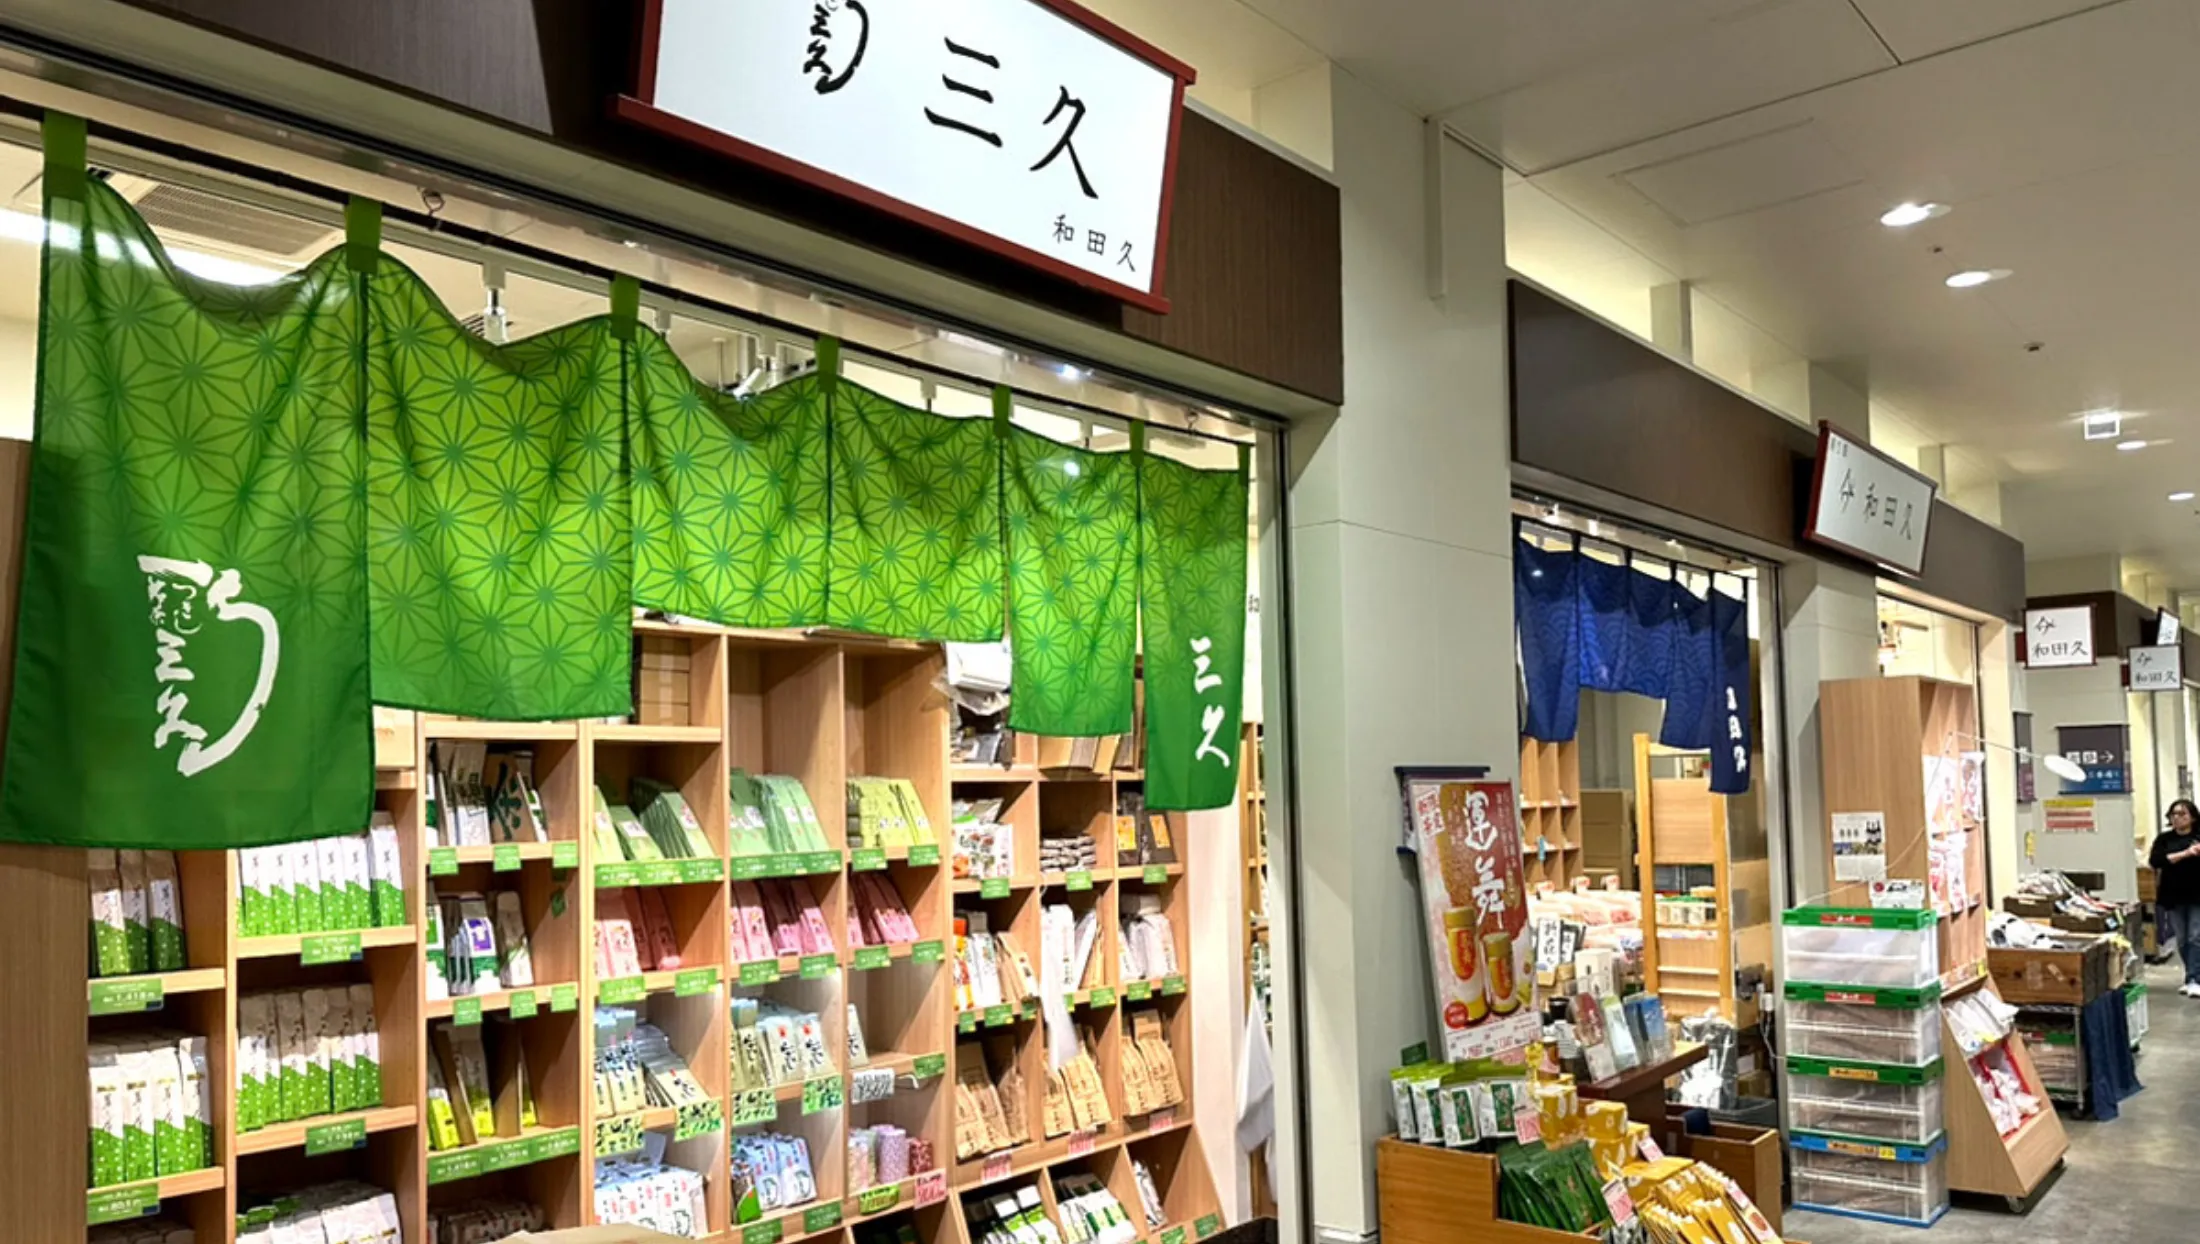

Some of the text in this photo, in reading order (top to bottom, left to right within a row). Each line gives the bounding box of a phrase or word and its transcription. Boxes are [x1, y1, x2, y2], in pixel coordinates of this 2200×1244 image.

[923, 36, 1099, 200] 三久
[1052, 213, 1136, 273] 和田久
[1863, 482, 1912, 540] 和田久
[2034, 641, 2089, 658] 和田久
[1190, 636, 1230, 768] 三久
